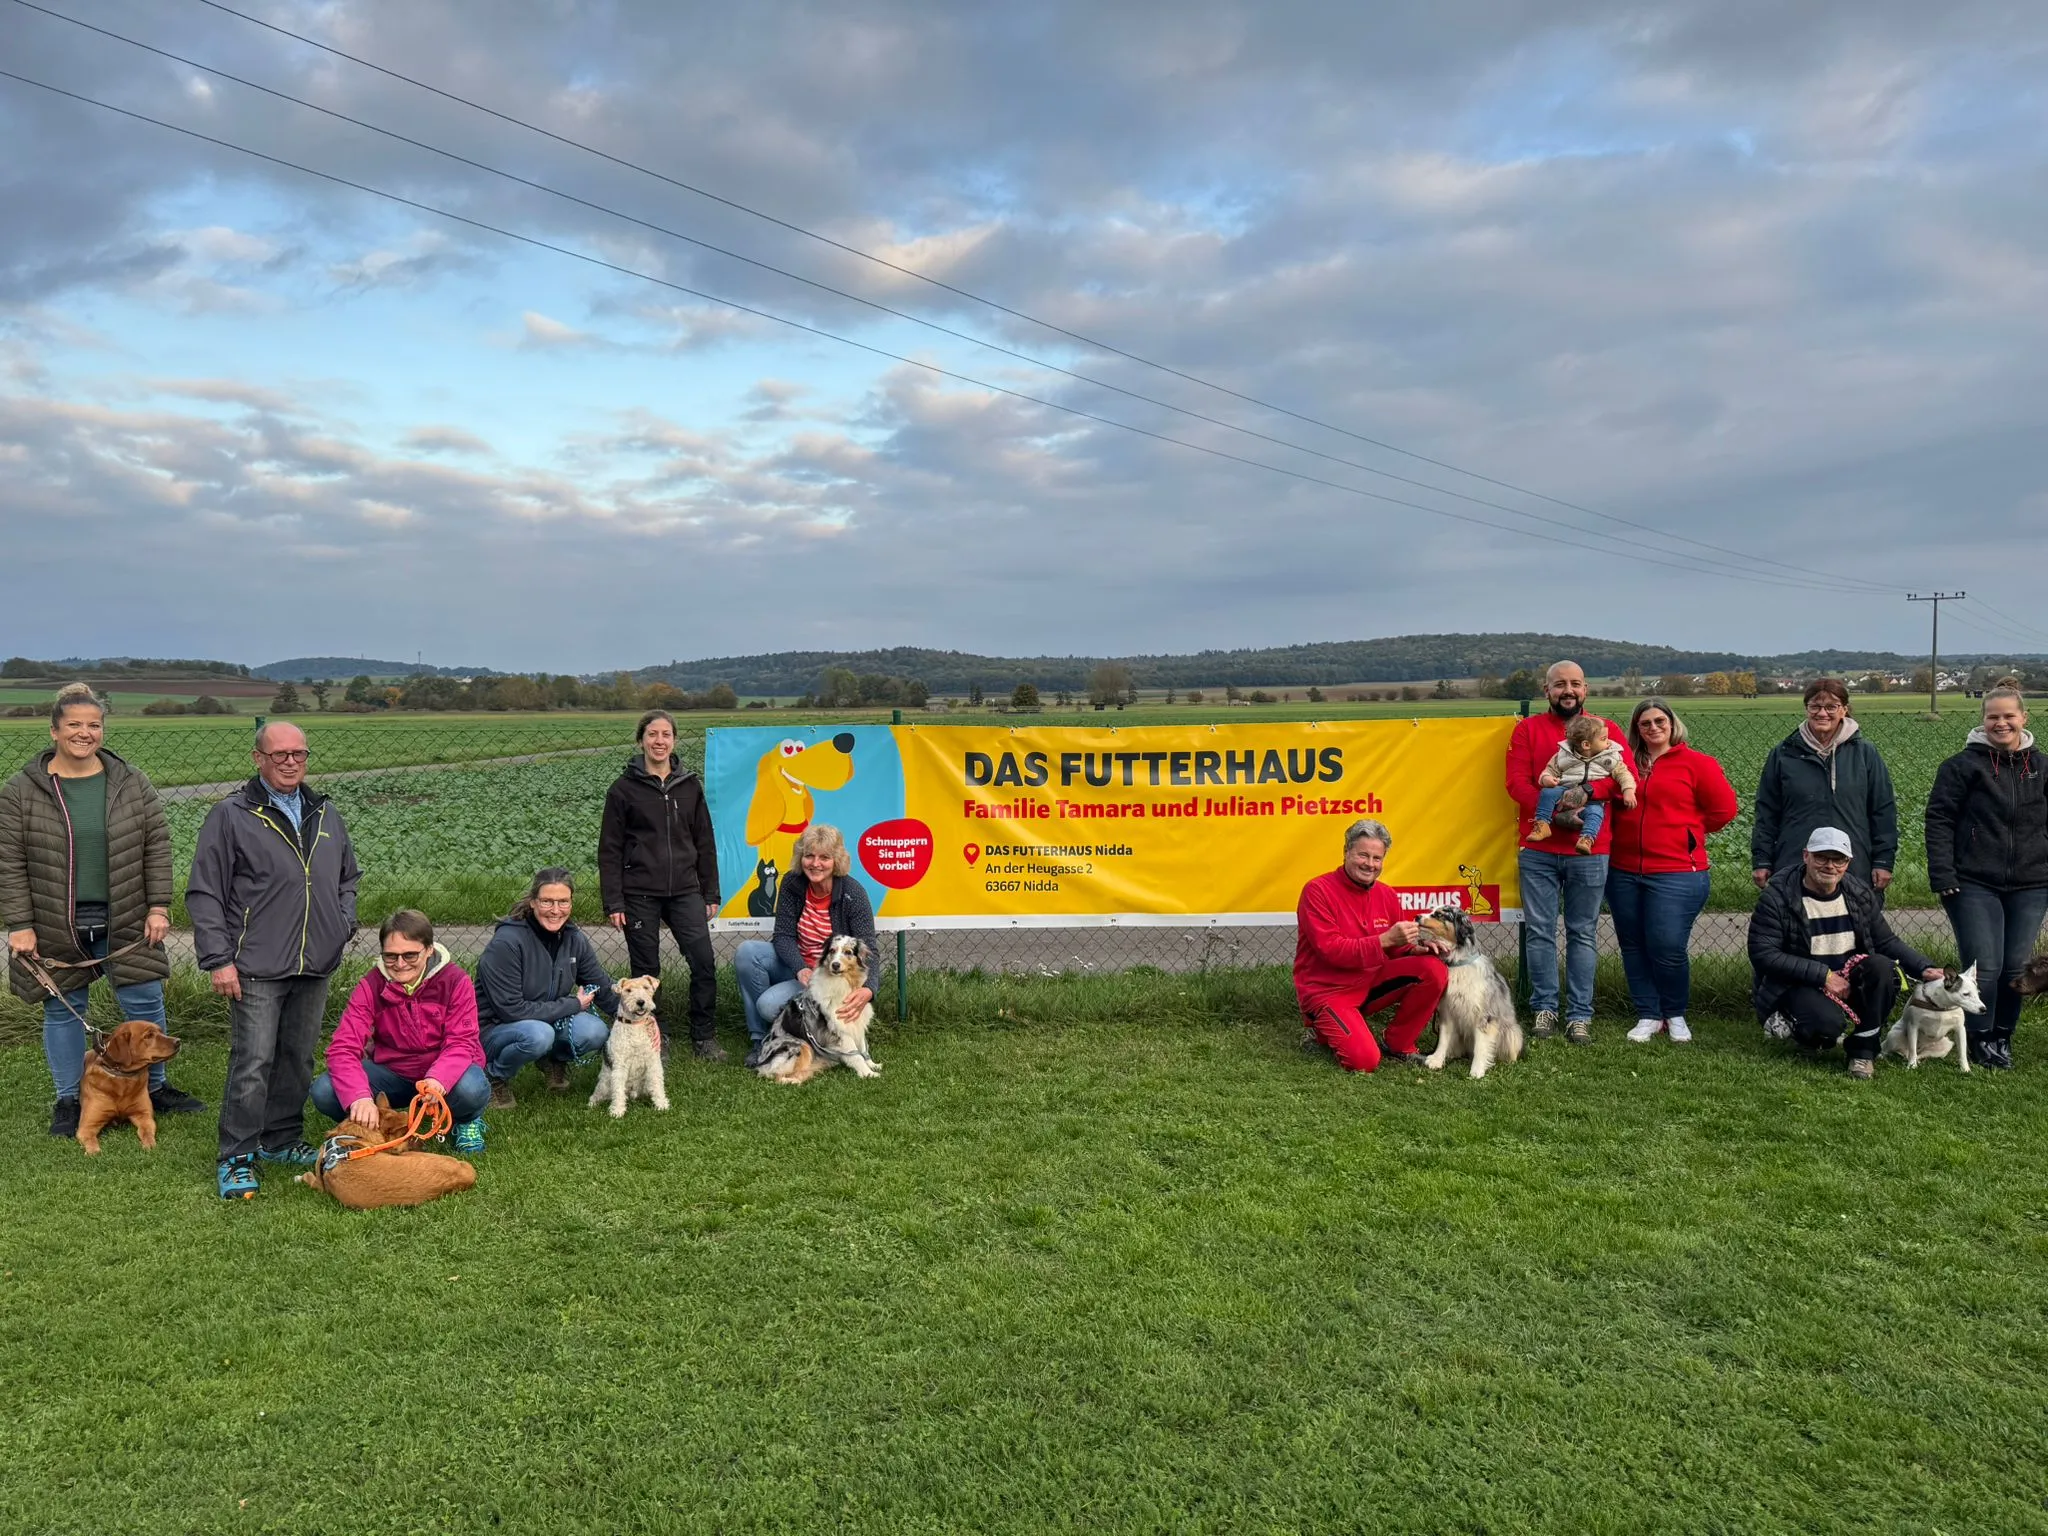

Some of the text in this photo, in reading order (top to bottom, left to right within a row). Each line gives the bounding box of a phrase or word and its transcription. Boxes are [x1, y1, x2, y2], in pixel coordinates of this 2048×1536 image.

[965, 747, 1343, 787] DAS FUTTERHAUS
[964, 792, 1382, 819] Familie Tamara und Julian Pietzsch
[865, 836, 928, 848] Schnuppern
[878, 848, 915, 859] Sie mal
[985, 844, 1133, 856] DAS FUTTERHAUS Nidda
[878, 860, 915, 870] vorbei!
[985, 862, 1093, 876] An der Heugasse 2
[985, 880, 1059, 892] 63667 Nidda
